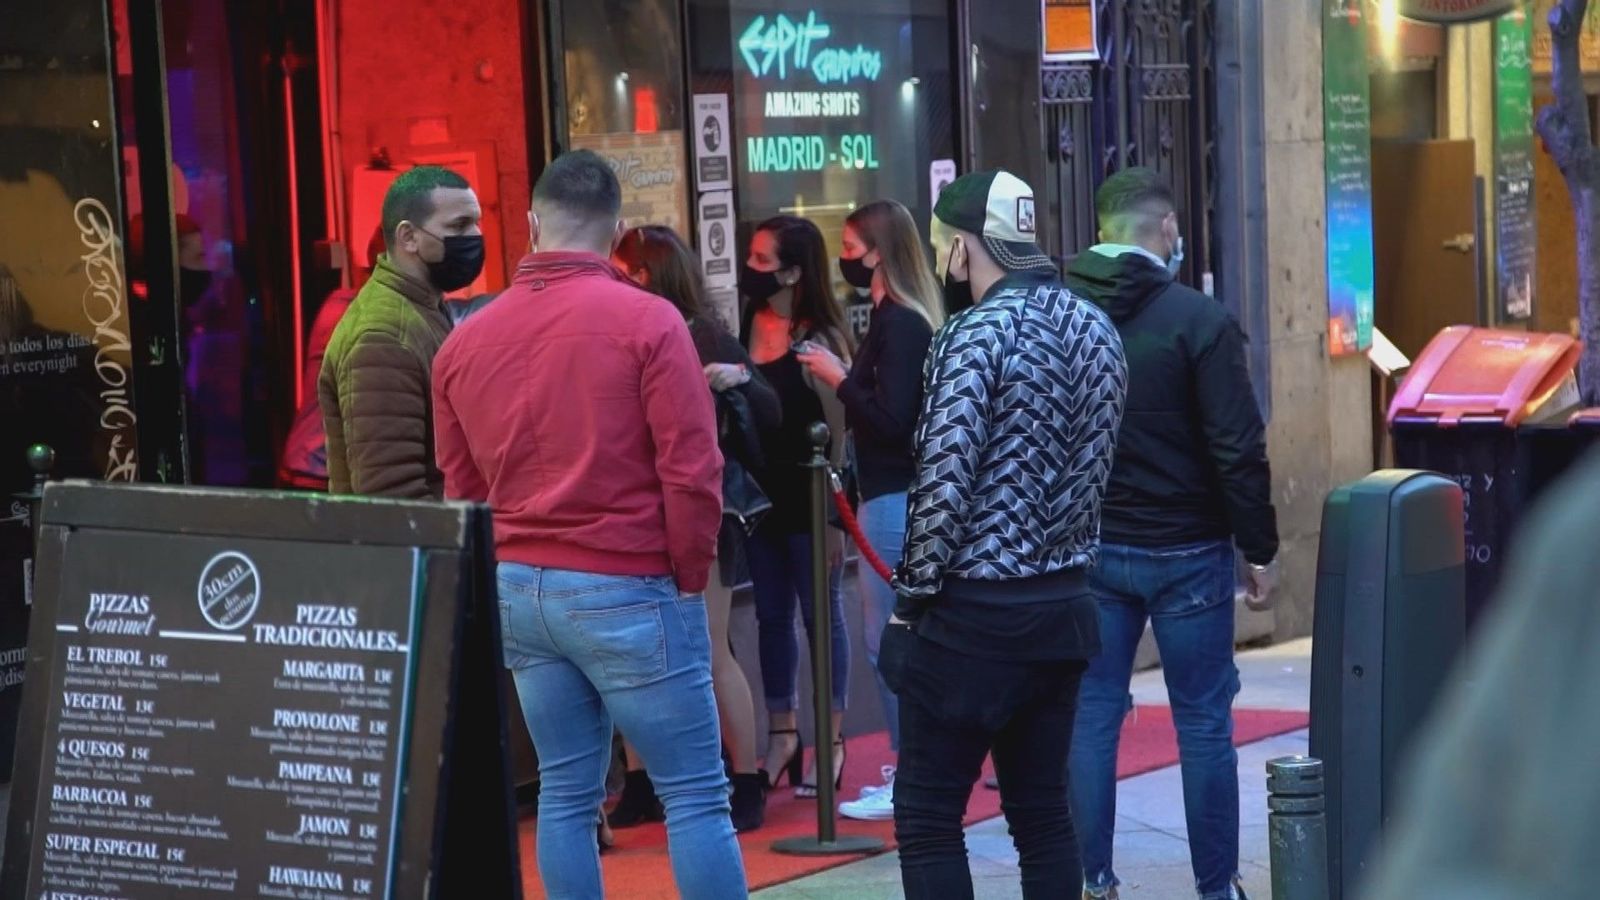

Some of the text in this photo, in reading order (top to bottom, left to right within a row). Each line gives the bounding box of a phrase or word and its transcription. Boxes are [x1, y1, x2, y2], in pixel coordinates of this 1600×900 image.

[765, 92, 861, 117] AMAZING SHOTS
[747, 135, 824, 172] MADRID
[840, 134, 879, 169] SOL
[9, 336, 43, 353] todos
[46, 334, 63, 350] los
[13, 353, 78, 375] everynight
[203, 563, 246, 599] 30cm
[89, 593, 150, 615] PIZZAS
[295, 604, 359, 627] PIZZAS
[84, 609, 156, 637] Gourmet
[252, 623, 400, 652] TRADICIONALES
[67, 645, 169, 668] EL TREBOL 15€
[283, 659, 394, 685] MARGARITA 13€
[62, 691, 155, 714] VEGETAL 13€
[273, 709, 389, 735] PROVOLONE 13€
[57, 738, 151, 761] 4 QUESOS 15€
[278, 761, 382, 787] PAMPEANA 13€
[52, 784, 154, 809] BARBACOA 15€
[296, 813, 379, 839] JAMON 13€
[45, 833, 186, 864] SUPER ESPECIAL 15€
[268, 865, 345, 892] HAWAIANA
[352, 878, 373, 894] 13€
